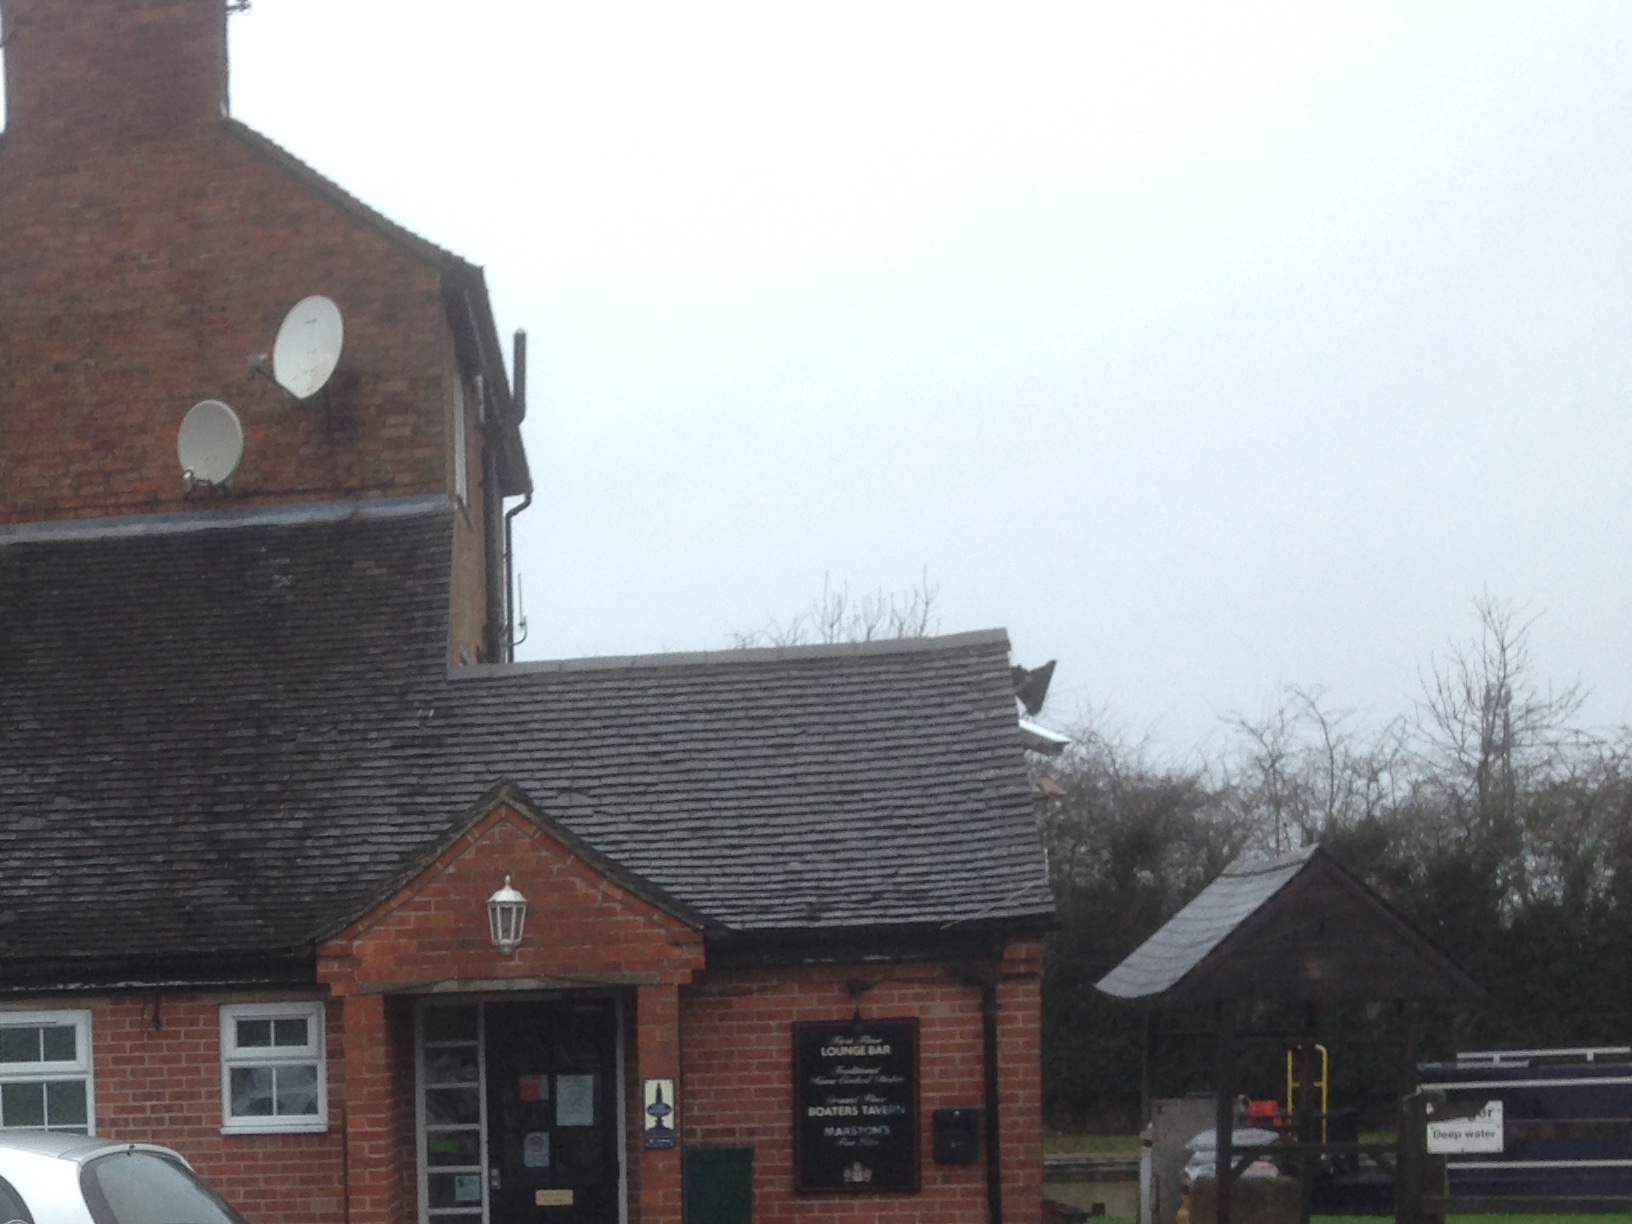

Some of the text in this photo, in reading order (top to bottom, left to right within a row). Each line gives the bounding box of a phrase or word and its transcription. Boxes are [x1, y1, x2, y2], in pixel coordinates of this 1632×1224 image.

[820, 1045, 892, 1057] LOUNGE BAR
[808, 1105, 859, 1117] BOATERS
[1433, 1128, 1495, 1142] Deep water
